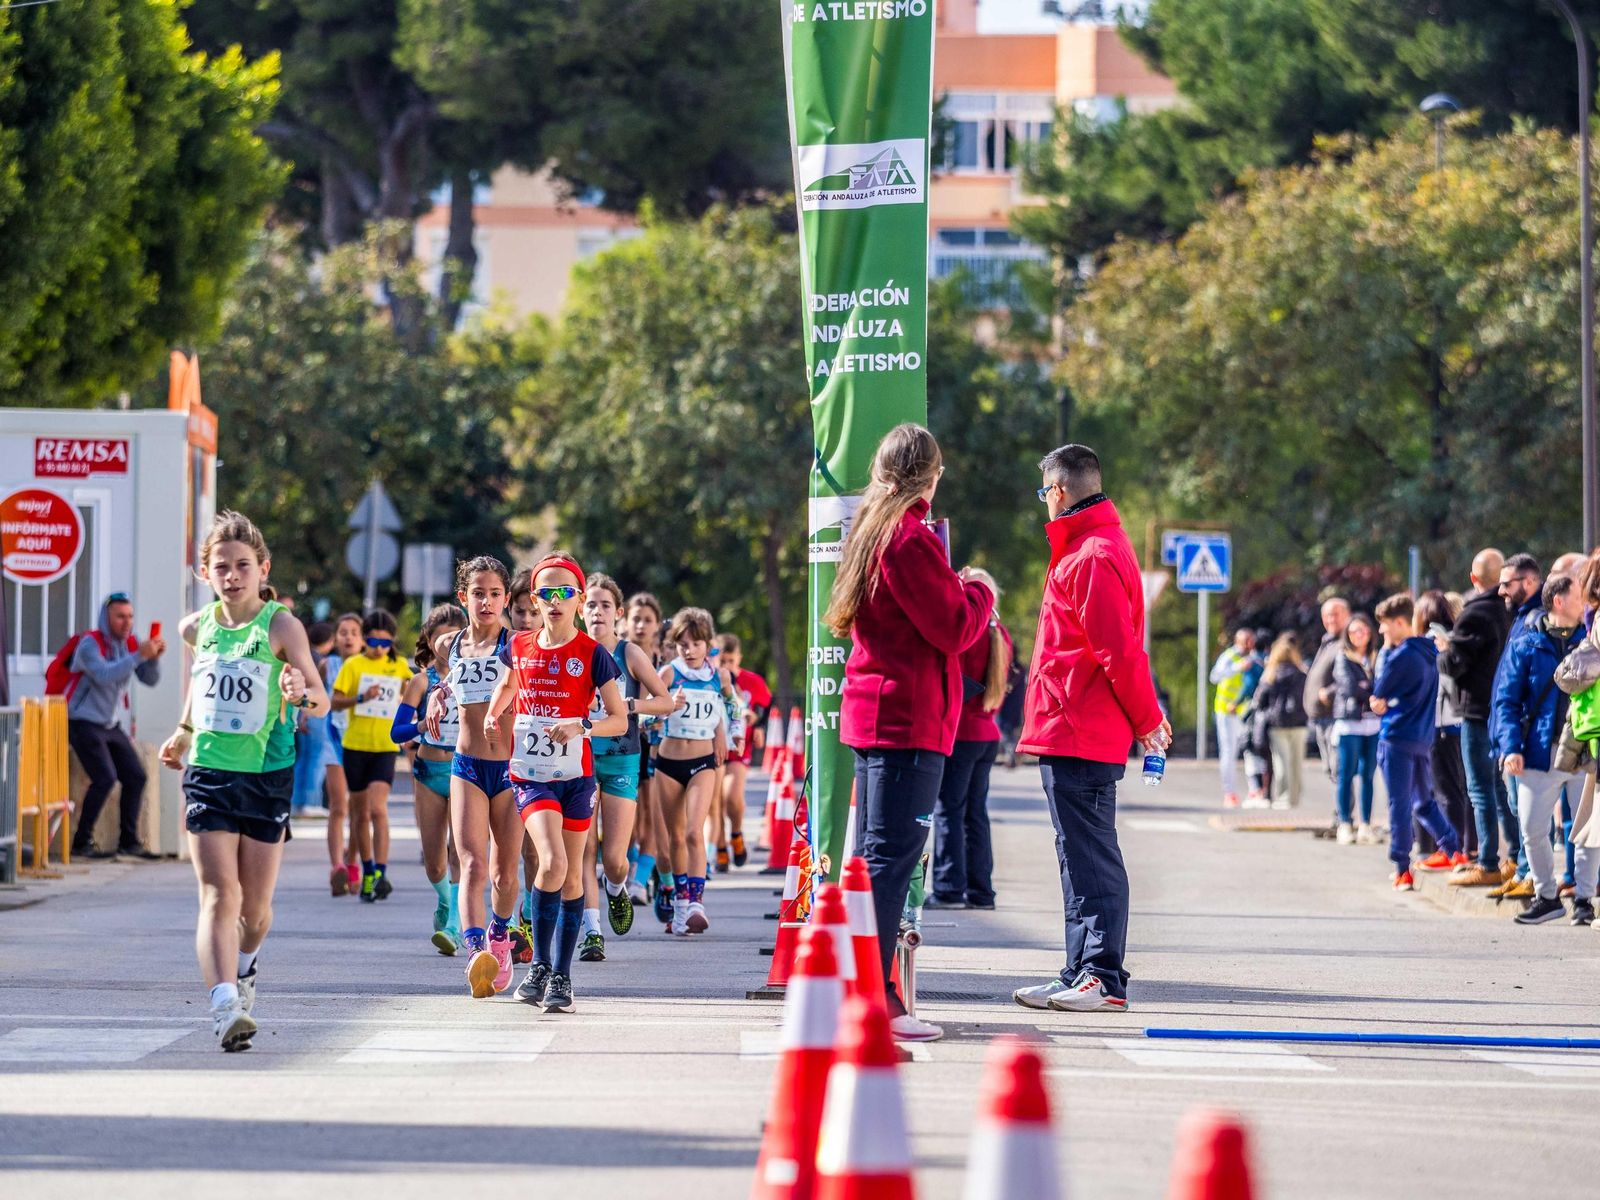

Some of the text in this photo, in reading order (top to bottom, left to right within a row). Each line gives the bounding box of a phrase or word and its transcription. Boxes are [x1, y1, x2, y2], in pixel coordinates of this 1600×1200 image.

[812, 0, 927, 21] ATLETISMO
[877, 187, 917, 196] ATLETISMO
[814, 352, 921, 377] ALETISMO
[37, 440, 127, 463] REMSA
[457, 660, 499, 684] 235
[205, 672, 253, 703] 208
[377, 687, 395, 702] 29
[538, 690, 571, 698] FERTILIDAD
[681, 702, 713, 719] 219
[526, 732, 569, 757] 231
